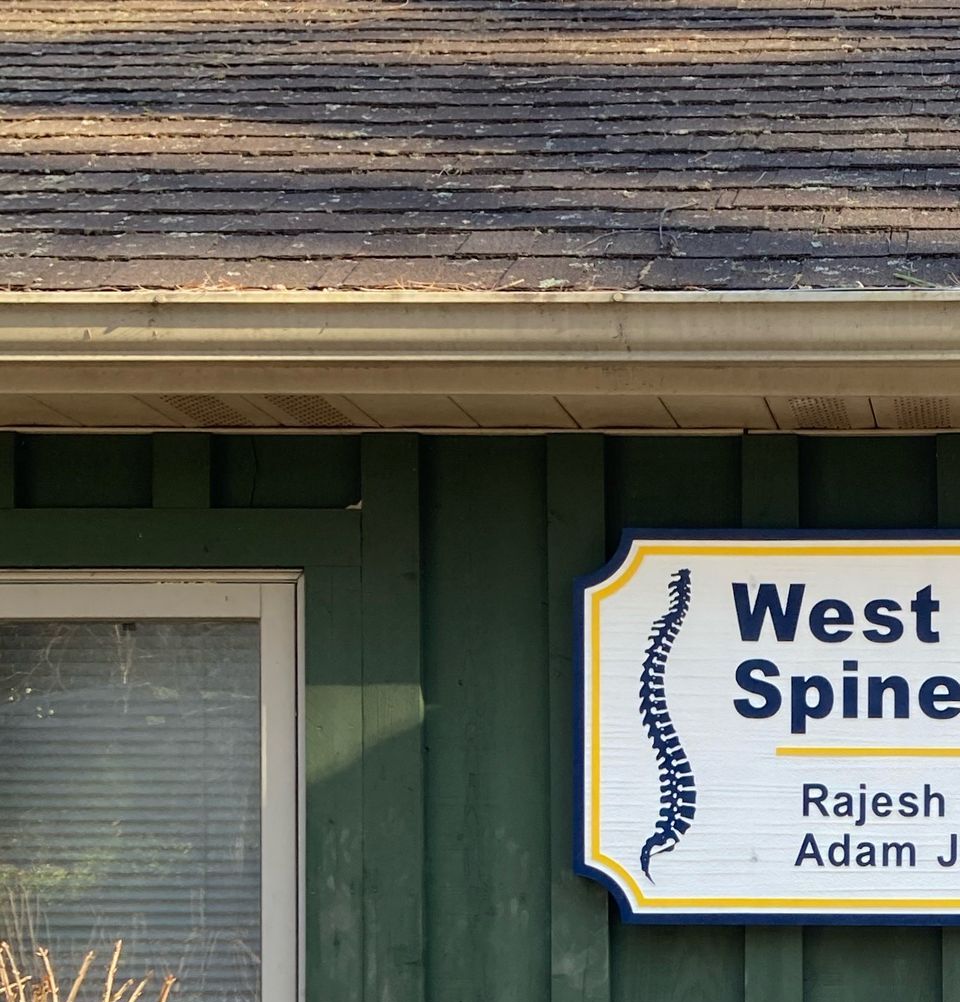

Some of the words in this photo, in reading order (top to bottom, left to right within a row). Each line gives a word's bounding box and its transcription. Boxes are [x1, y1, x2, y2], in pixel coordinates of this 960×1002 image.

[731, 582, 940, 644] West
[802, 783, 945, 827] Rajesh
[794, 833, 916, 868] Adam
